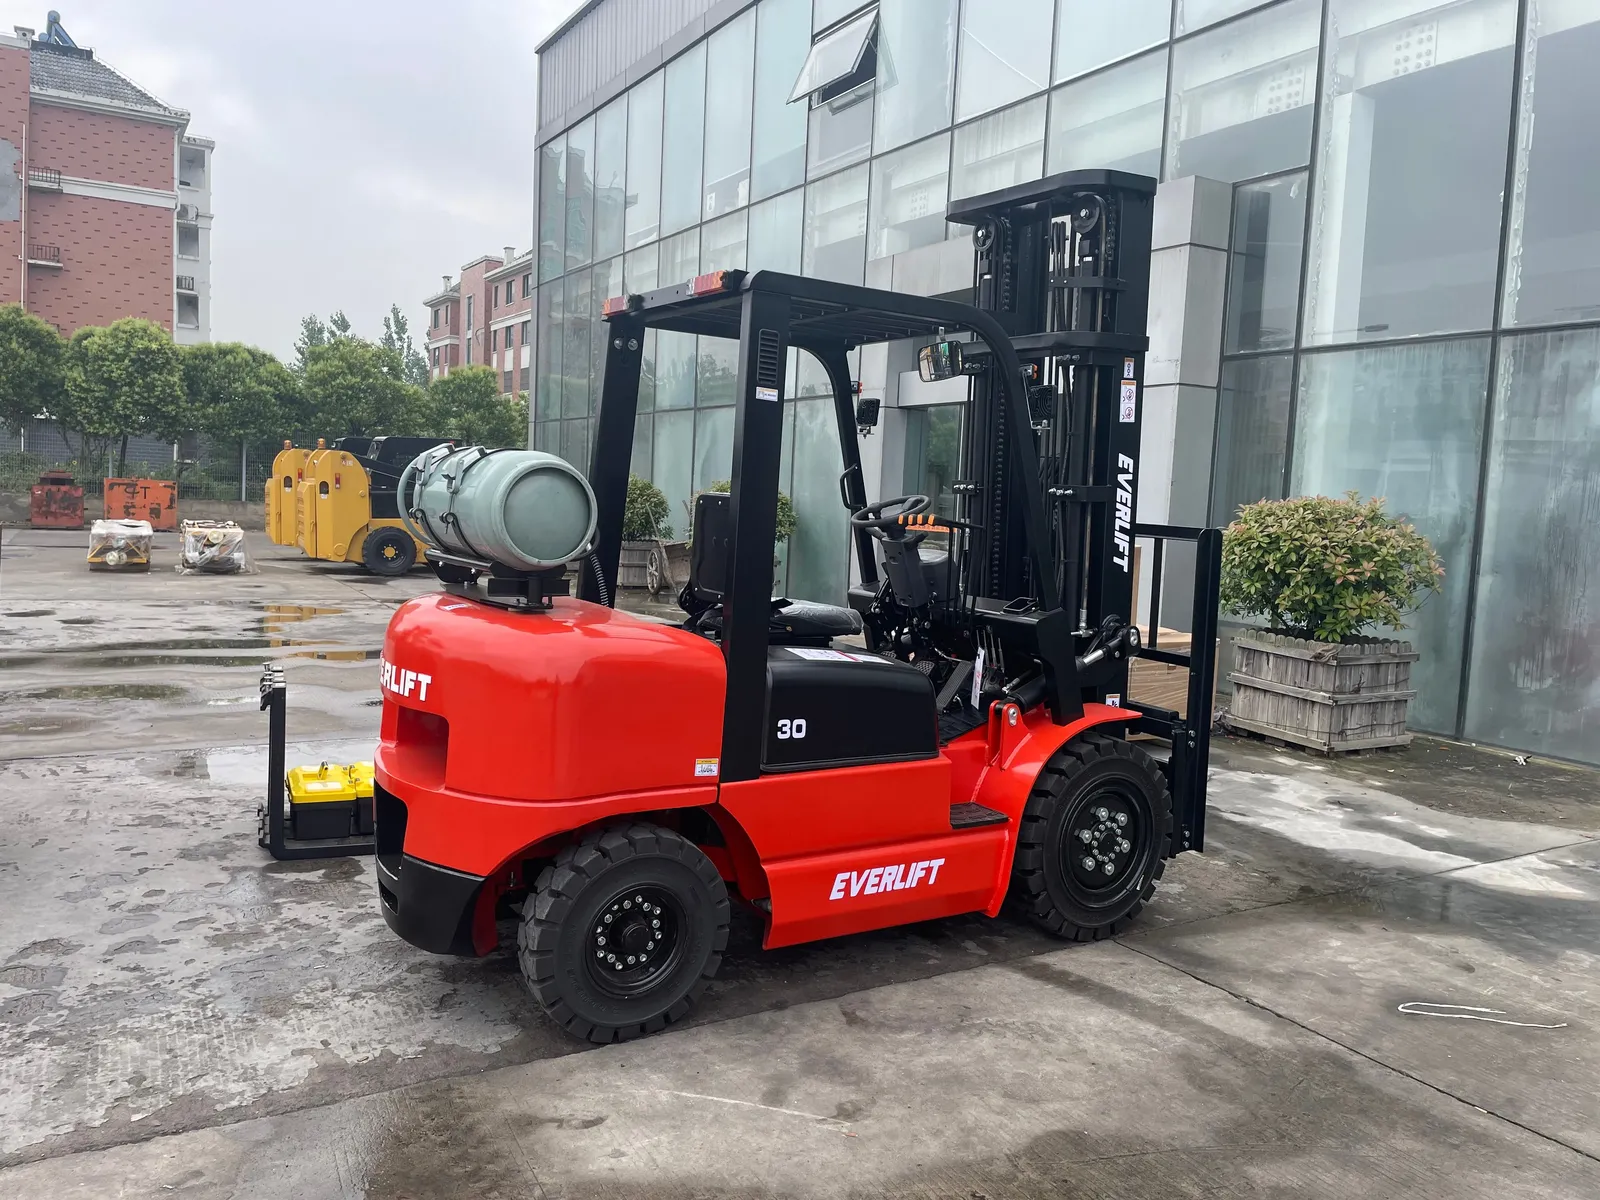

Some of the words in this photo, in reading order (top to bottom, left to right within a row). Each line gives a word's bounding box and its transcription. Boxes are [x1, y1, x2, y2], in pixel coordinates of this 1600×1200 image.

[1113, 453, 1134, 573] EVERLIFT
[777, 718, 807, 740] 30
[829, 858, 946, 901] EVERLIFT
